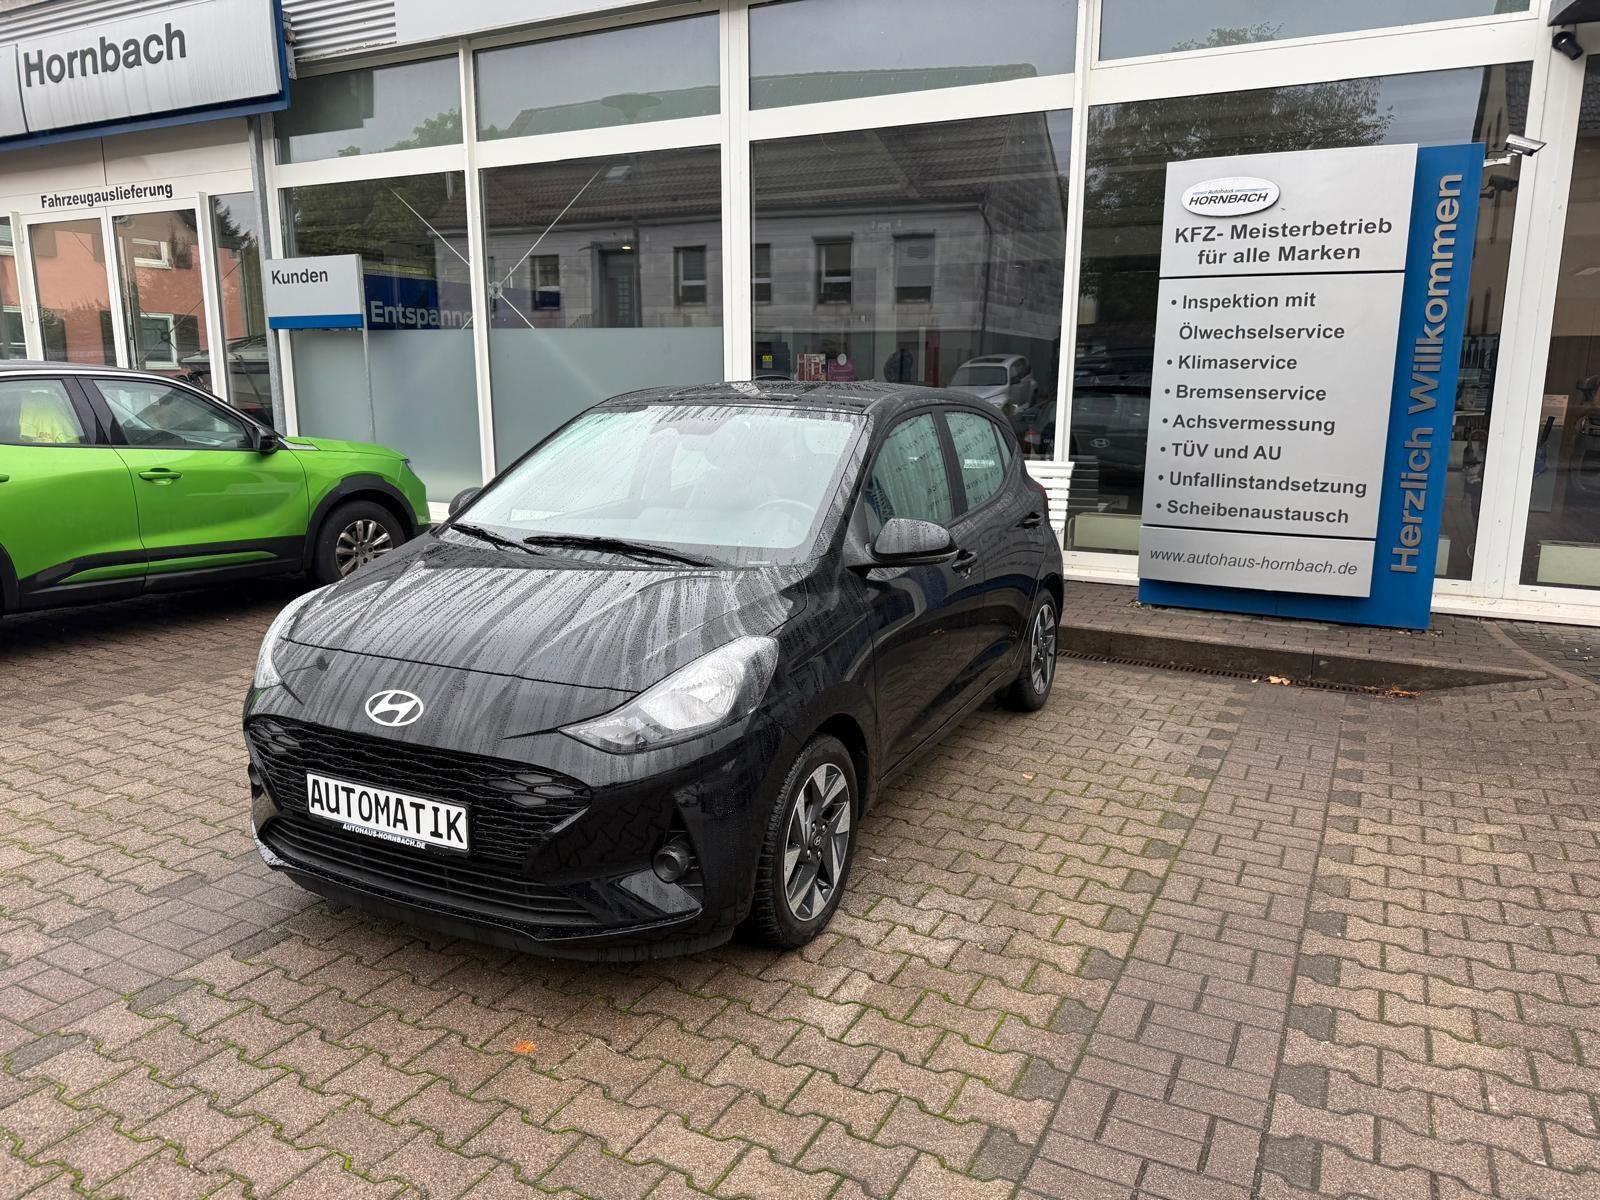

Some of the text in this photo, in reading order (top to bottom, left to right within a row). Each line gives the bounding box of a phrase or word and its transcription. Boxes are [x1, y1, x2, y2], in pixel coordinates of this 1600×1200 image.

[23, 22, 186, 87] Hornbach
[40, 184, 173, 209] Fahrzeugauslieferung
[1188, 192, 1269, 206] HORNBACH
[1175, 218, 1393, 243] KFZ- Meisterbetrieb
[1197, 245, 1361, 264] für alle Marken
[271, 267, 329, 285] Kunden
[1182, 292, 1316, 312] Inspektion mit
[1179, 322, 1345, 340] Ölwechselservice
[1178, 354, 1298, 370] Klimaservice
[1390, 174, 1464, 574] Herzlich Willkommen
[1176, 384, 1327, 401] Bremsenservice
[1172, 414, 1336, 436] Achsvermessung
[1172, 440, 1282, 460] TÜV und AU
[1169, 471, 1368, 498] Unfallinstandsetzung
[1167, 500, 1349, 523] Scheibenaustausch
[1149, 549, 1358, 575] www.autohaus-hornbach.de
[311, 779, 464, 843] AUTOMATIK
[342, 823, 427, 849] AUTOHAUS-HORNBACH.DE
